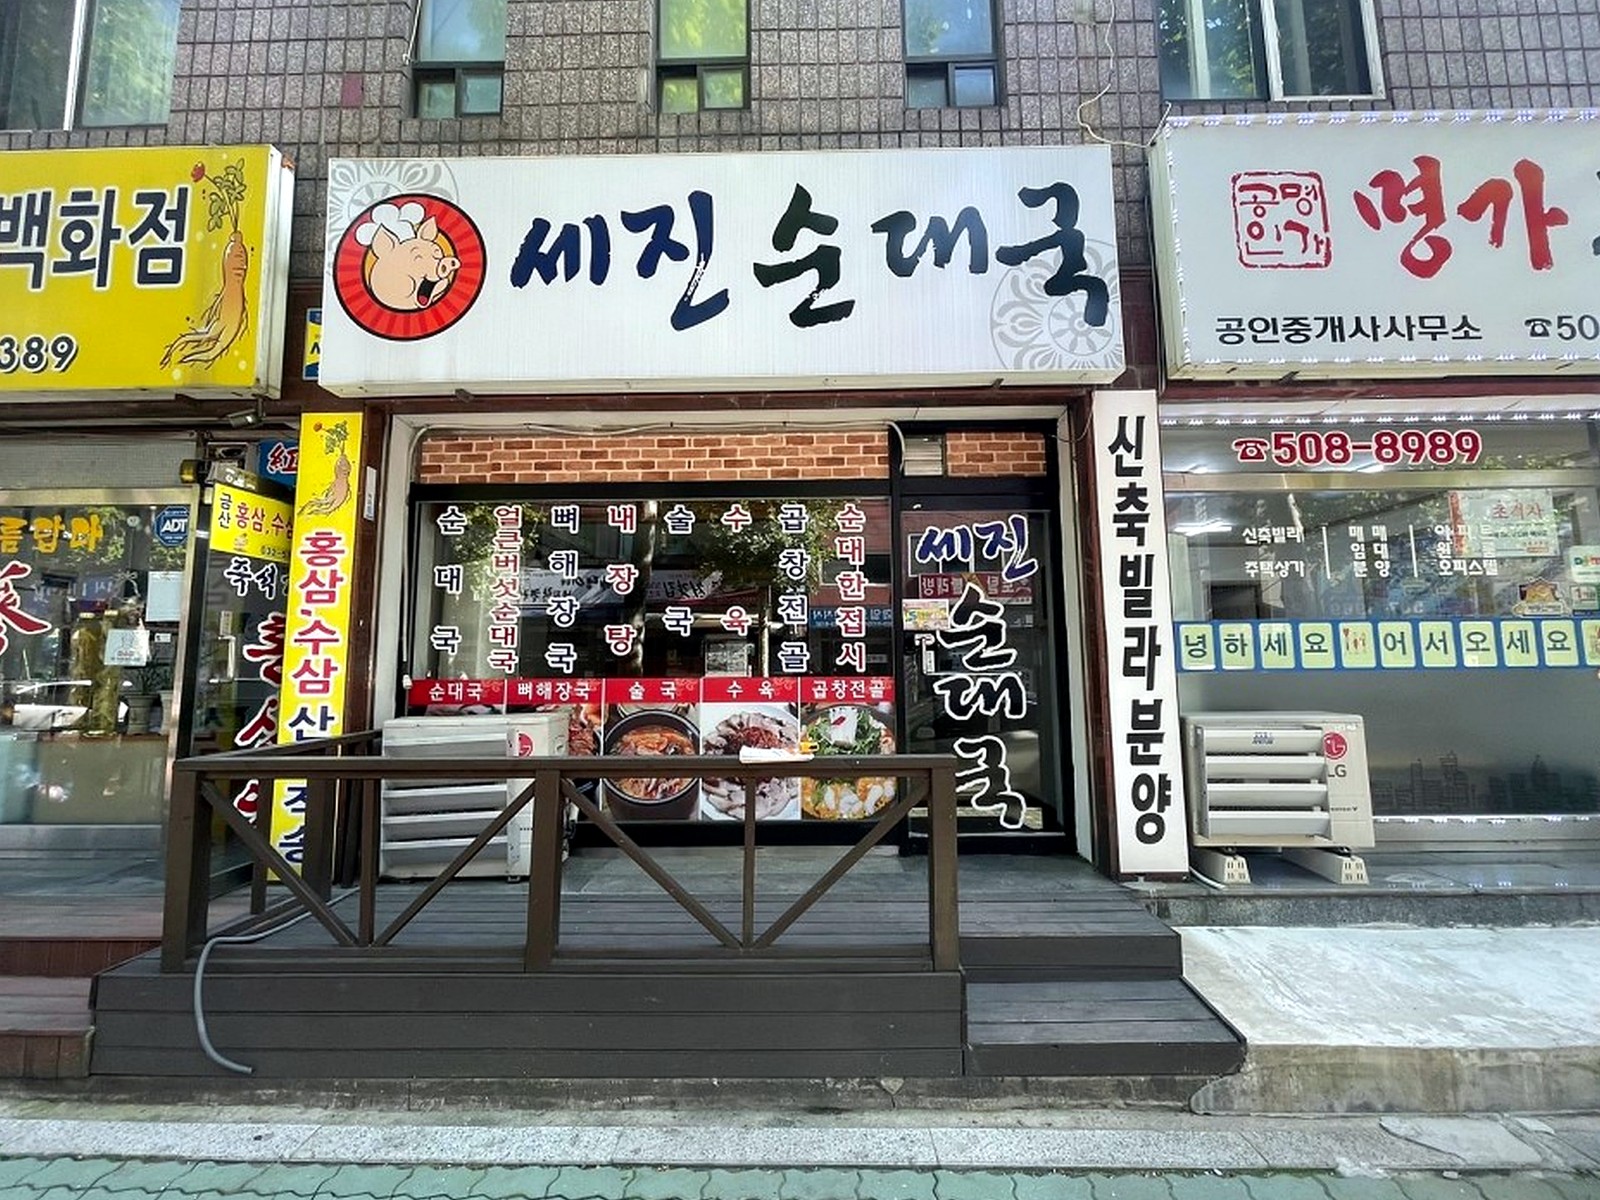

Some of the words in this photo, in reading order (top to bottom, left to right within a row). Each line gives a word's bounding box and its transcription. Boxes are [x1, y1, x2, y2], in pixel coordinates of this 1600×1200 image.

[1353, 155, 1568, 279] 명가
[0, 187, 189, 289] 백화점
[511, 189, 731, 331] 세진
[752, 182, 1109, 328] 순대국
[1215, 314, 1482, 346] 공인중개사사무소
[0, 336, 77, 372] 389
[1271, 430, 1483, 466] 508-8989
[160, 518, 188, 533] ADT
[218, 492, 233, 529] 금산
[915, 514, 1038, 582] 세진
[1242, 526, 1304, 544] 신축빌라
[1350, 543, 1390, 560] 임대
[431, 506, 467, 654] 순대국
[605, 506, 639, 656] 내장탕
[662, 504, 695, 637] 술국
[720, 504, 752, 637] 수육
[1244, 560, 1305, 578] 주택상가
[1353, 561, 1391, 578] 분양
[1439, 559, 1498, 576] 오피스텔
[488, 506, 523, 673] 얼큰버섯순대국
[545, 505, 580, 673] 뼈해장국
[777, 504, 810, 673] 곱창전골
[1107, 414, 1172, 845] 신축빌라분양
[1183, 632, 1329, 659] 녕하세요
[1383, 630, 1572, 656] 어서오세요
[428, 682, 484, 702] 순대국
[517, 682, 591, 702] 뼈해장국
[628, 681, 677, 701] 술국
[726, 680, 775, 700] 수육
[811, 680, 886, 700] 곱창전골
[934, 582, 1027, 829] 순대국
